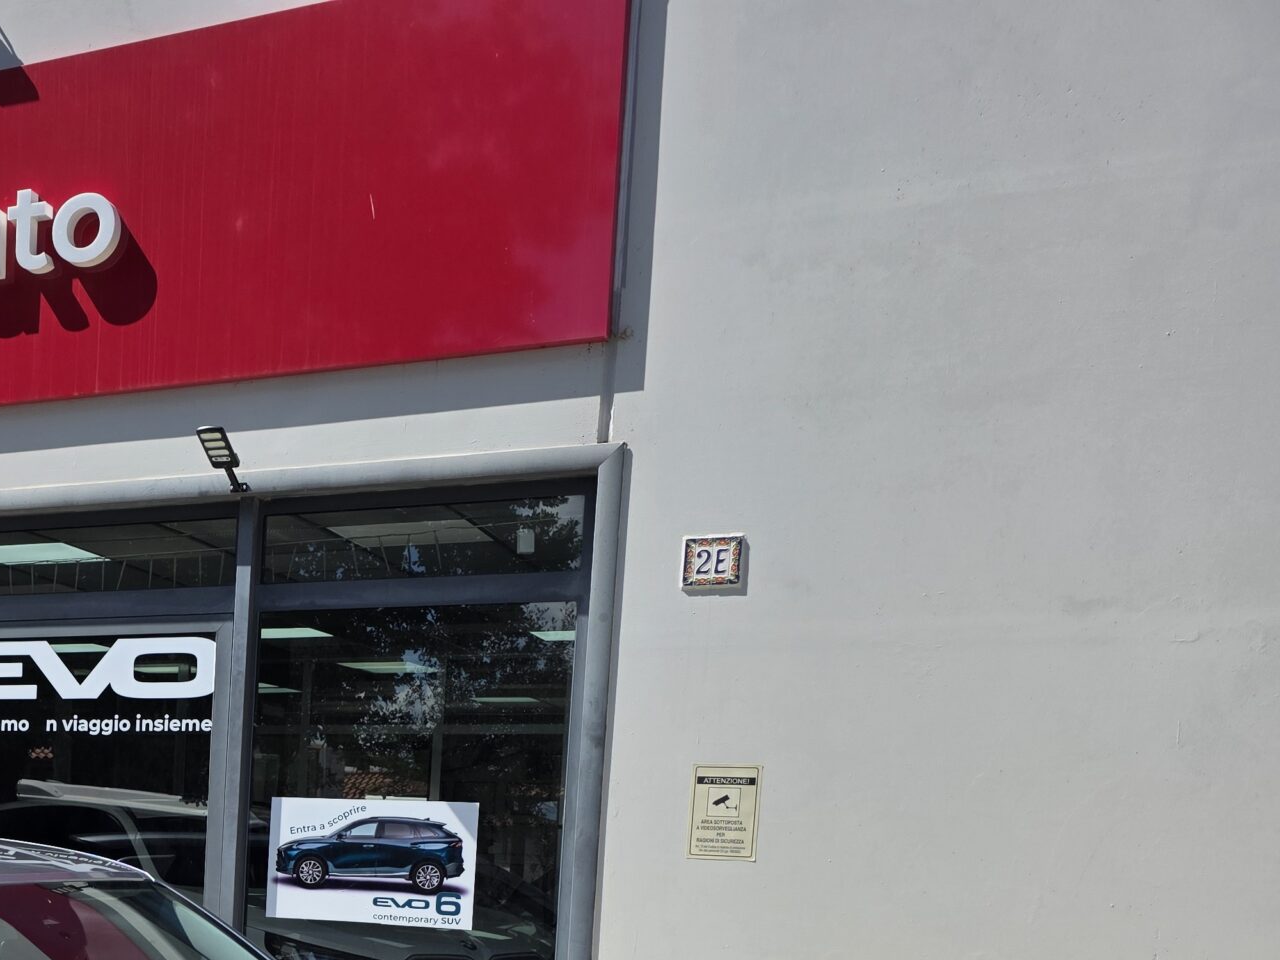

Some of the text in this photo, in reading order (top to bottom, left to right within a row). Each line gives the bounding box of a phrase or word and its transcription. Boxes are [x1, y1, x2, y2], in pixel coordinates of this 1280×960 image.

[696, 548, 730, 575] 2E
[62, 714, 131, 736] viaggio
[135, 713, 213, 732] insieme
[703, 777, 750, 785] ATTENZIONE!
[289, 804, 368, 835] Entra a scoprire
[372, 892, 462, 916] EVO 6
[372, 912, 462, 926] contemporary SUV
